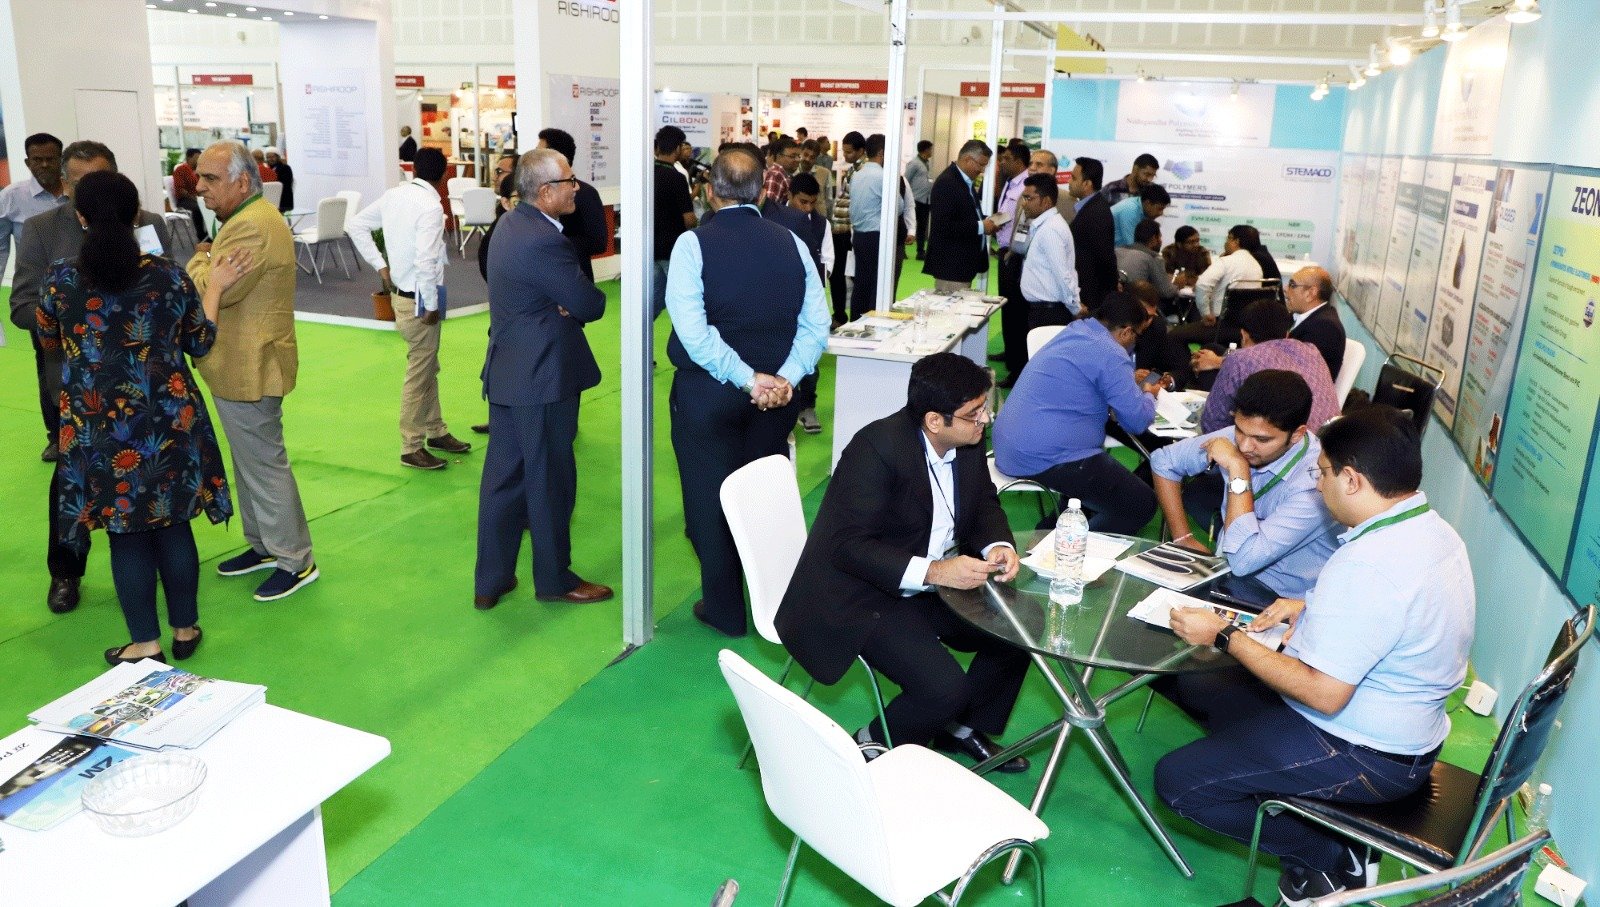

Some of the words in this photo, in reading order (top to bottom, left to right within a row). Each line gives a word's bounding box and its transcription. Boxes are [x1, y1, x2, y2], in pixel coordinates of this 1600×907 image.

[662, 115, 709, 125] CILBOND
[1286, 167, 1332, 178] STEMACO
[1168, 183, 1207, 192] POLYMERS
[1572, 187, 1600, 217] ZEON
